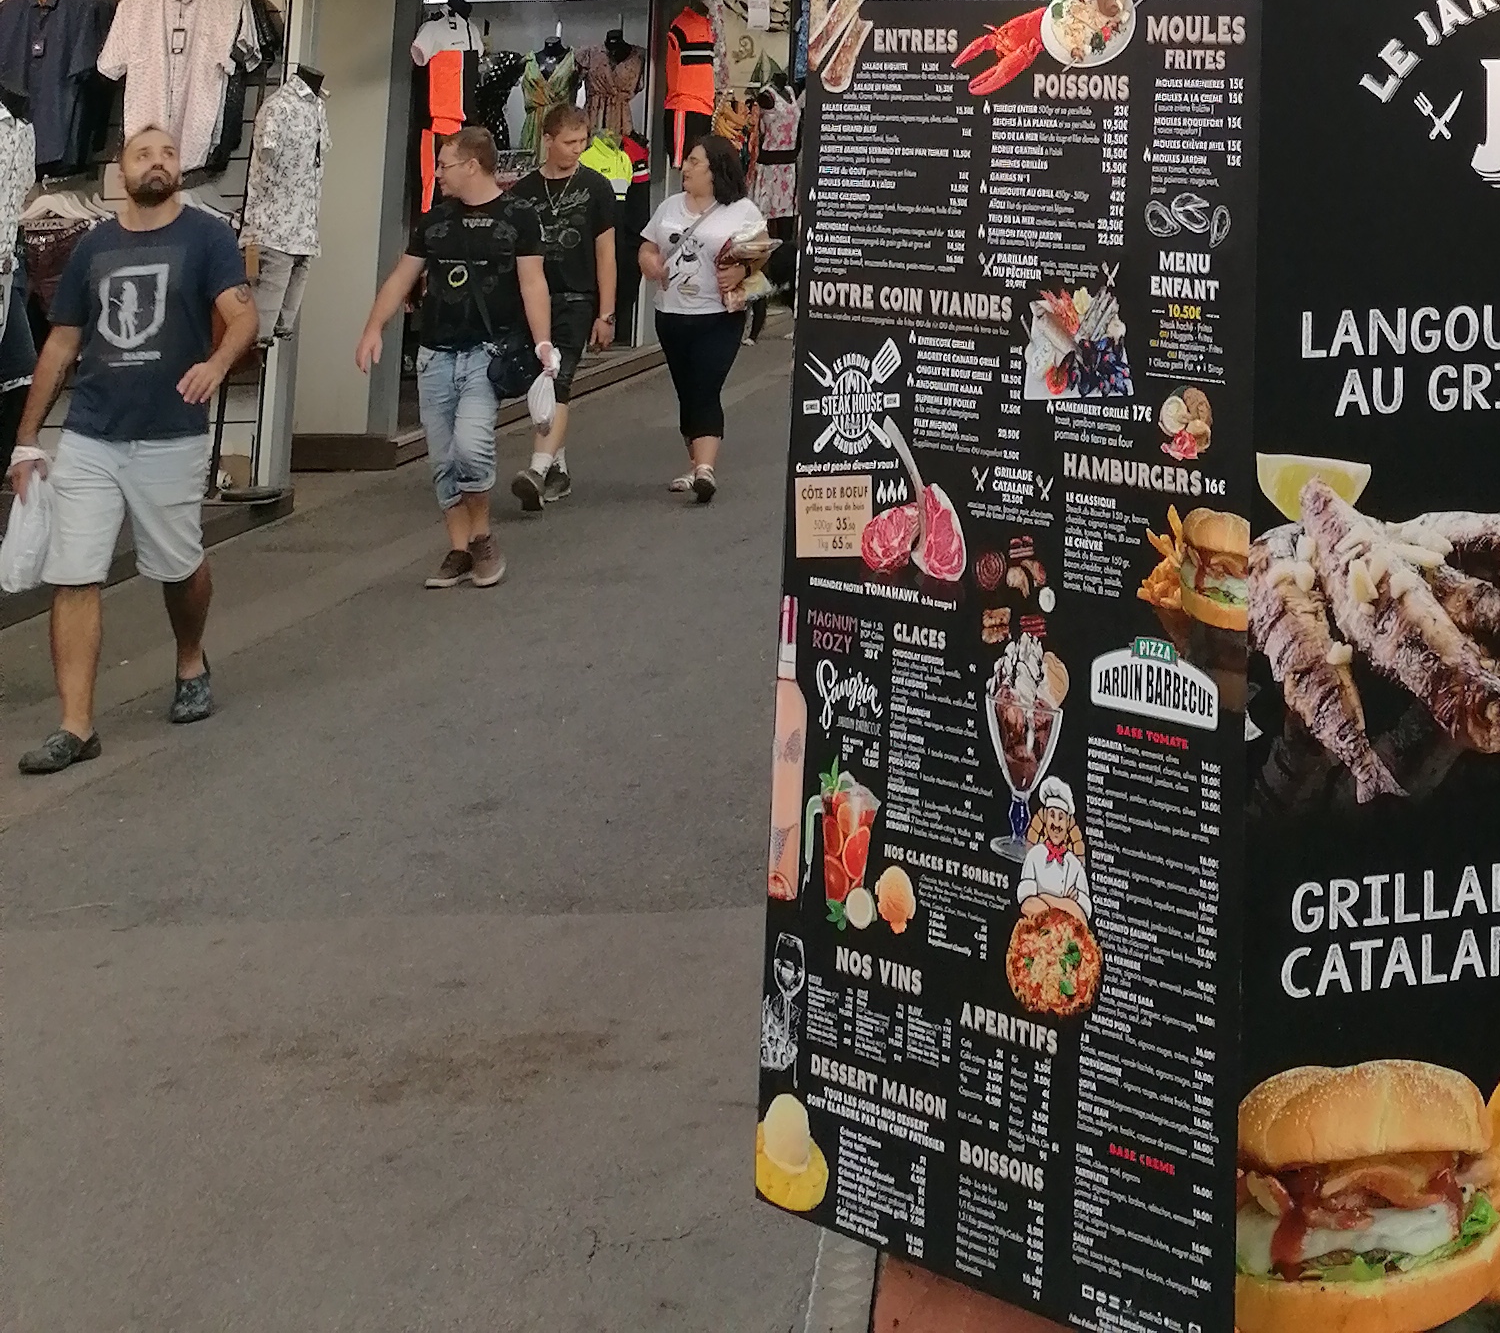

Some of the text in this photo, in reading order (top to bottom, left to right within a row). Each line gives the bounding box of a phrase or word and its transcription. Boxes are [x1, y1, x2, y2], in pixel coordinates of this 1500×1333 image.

[873, 28, 959, 54] ENTREES
[1146, 15, 1247, 45] MOULES
[1164, 49, 1226, 71] FRITES
[1359, 38, 1423, 103] LE
[1033, 74, 1130, 101] POISSONS
[1159, 250, 1212, 274] MENU
[809, 280, 1013, 322] NOTRE COIN VIANDES
[1150, 275, 1220, 301] ENFANT
[822, 392, 884, 416] STEAK HOUSE
[1334, 369, 1404, 418] AU
[1055, 401, 1101, 417] CAMEMBERT
[1132, 405, 1152, 424] 17€
[1063, 452, 1226, 496] HAMBURGERS 16€
[802, 485, 868, 500] CÔTE DE BOEUF
[864, 582, 920, 604] TOMAHAWK
[807, 609, 859, 633] MAGNUM
[812, 629, 853, 655] ROZY
[1139, 639, 1172, 661] PIZZA
[816, 659, 884, 733] Sangria
[1098, 664, 1214, 718] JARDIN BARBECUE
[884, 843, 904, 861] NOS
[945, 860, 960, 876] ET
[962, 863, 1009, 889] SORBETS
[835, 945, 923, 996] NOS VINS
[960, 1001, 1058, 1055] APERITIFS
[810, 1053, 947, 1121] DESSERT MAISON
[960, 1139, 1045, 1192] BOISSONS
